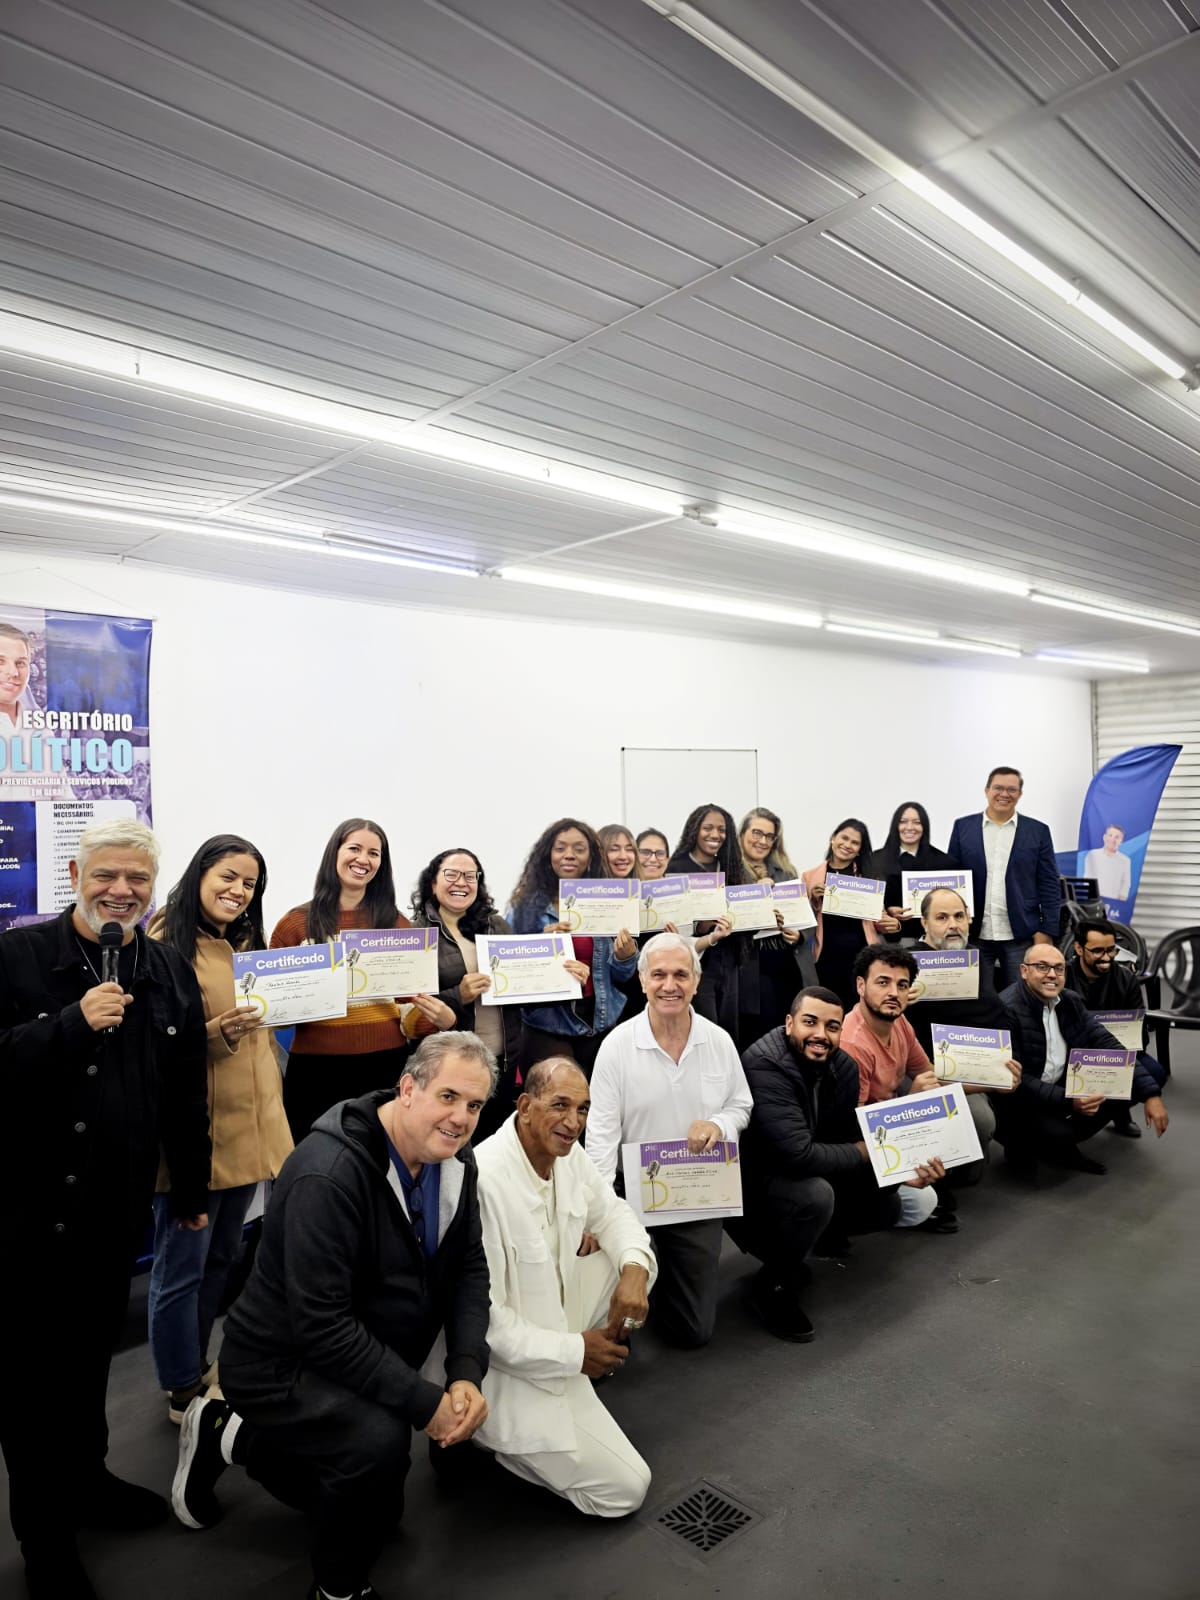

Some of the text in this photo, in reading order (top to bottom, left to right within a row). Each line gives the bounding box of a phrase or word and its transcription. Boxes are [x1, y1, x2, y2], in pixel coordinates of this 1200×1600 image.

[22, 709, 133, 732] ESCRITÓRIO
[66, 777, 101, 786] SERVIÇOS
[102, 776, 133, 786] PÚBLICOS
[53, 802, 94, 810] DOCUMENTOS
[53, 810, 94, 818] NECESSÁRIOS
[575, 886, 625, 894] Certificado
[837, 878, 874, 891] Certificado
[360, 936, 421, 948] Certificado
[498, 945, 550, 956] Certificado
[255, 952, 325, 970] Certificado
[919, 956, 965, 965] Certificado
[947, 1032, 996, 1044] Certificado
[1082, 1054, 1124, 1064] Certificado
[883, 1104, 941, 1124] Certificado
